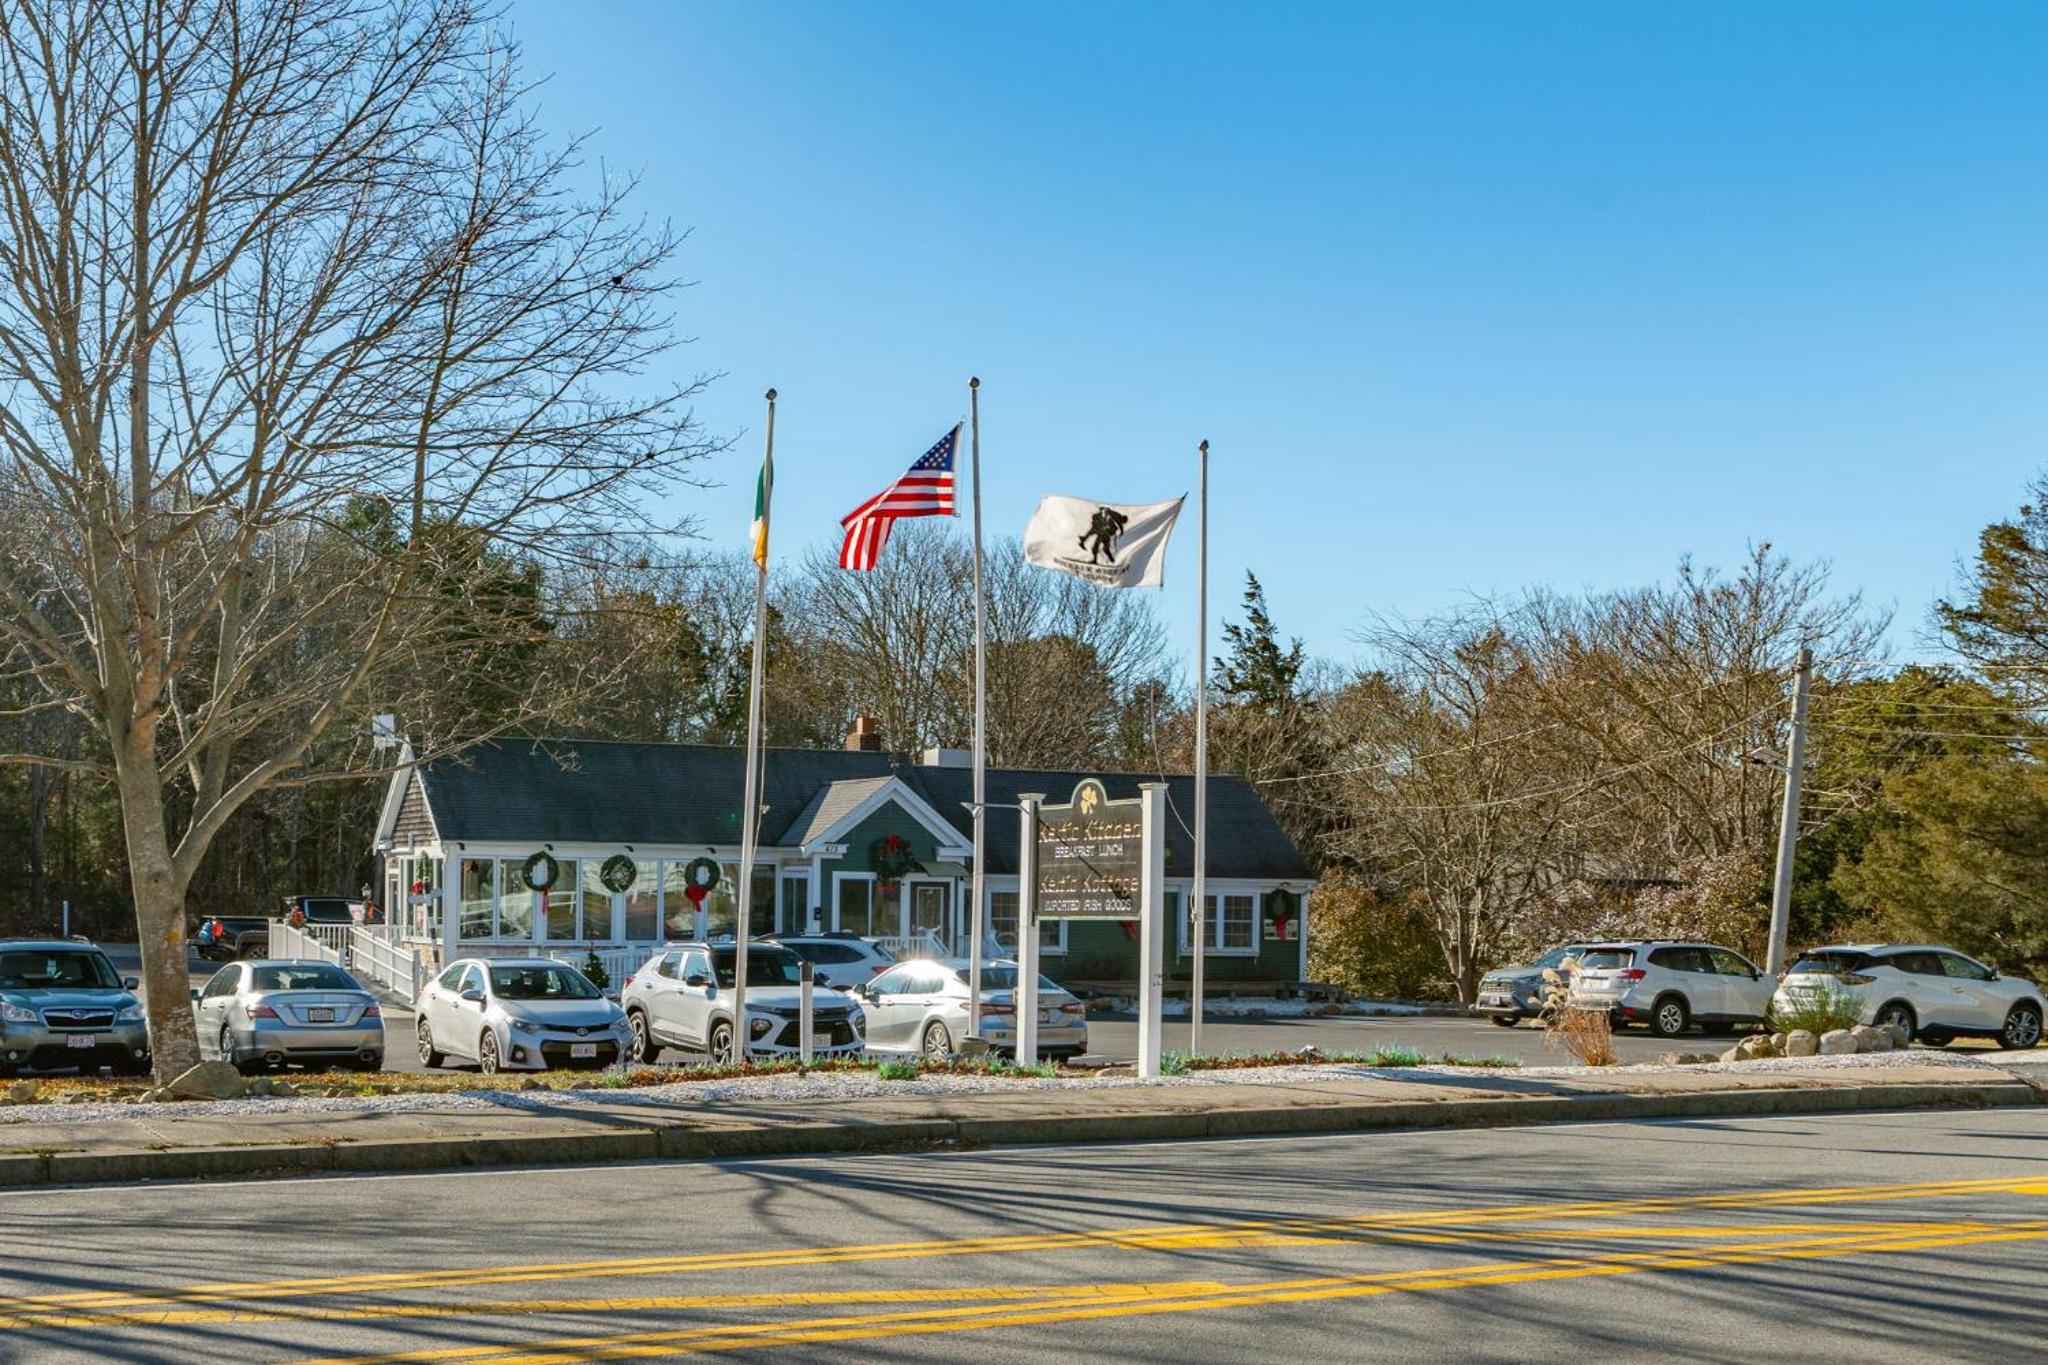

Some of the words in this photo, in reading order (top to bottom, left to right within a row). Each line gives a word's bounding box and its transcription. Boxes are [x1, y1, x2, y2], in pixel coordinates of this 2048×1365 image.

[1054, 845, 1095, 858] BREAKFAST
[1098, 843, 1123, 857] LUNCH
[1044, 899, 1081, 912] IMPORTED
[1105, 898, 1132, 911] GOODS
